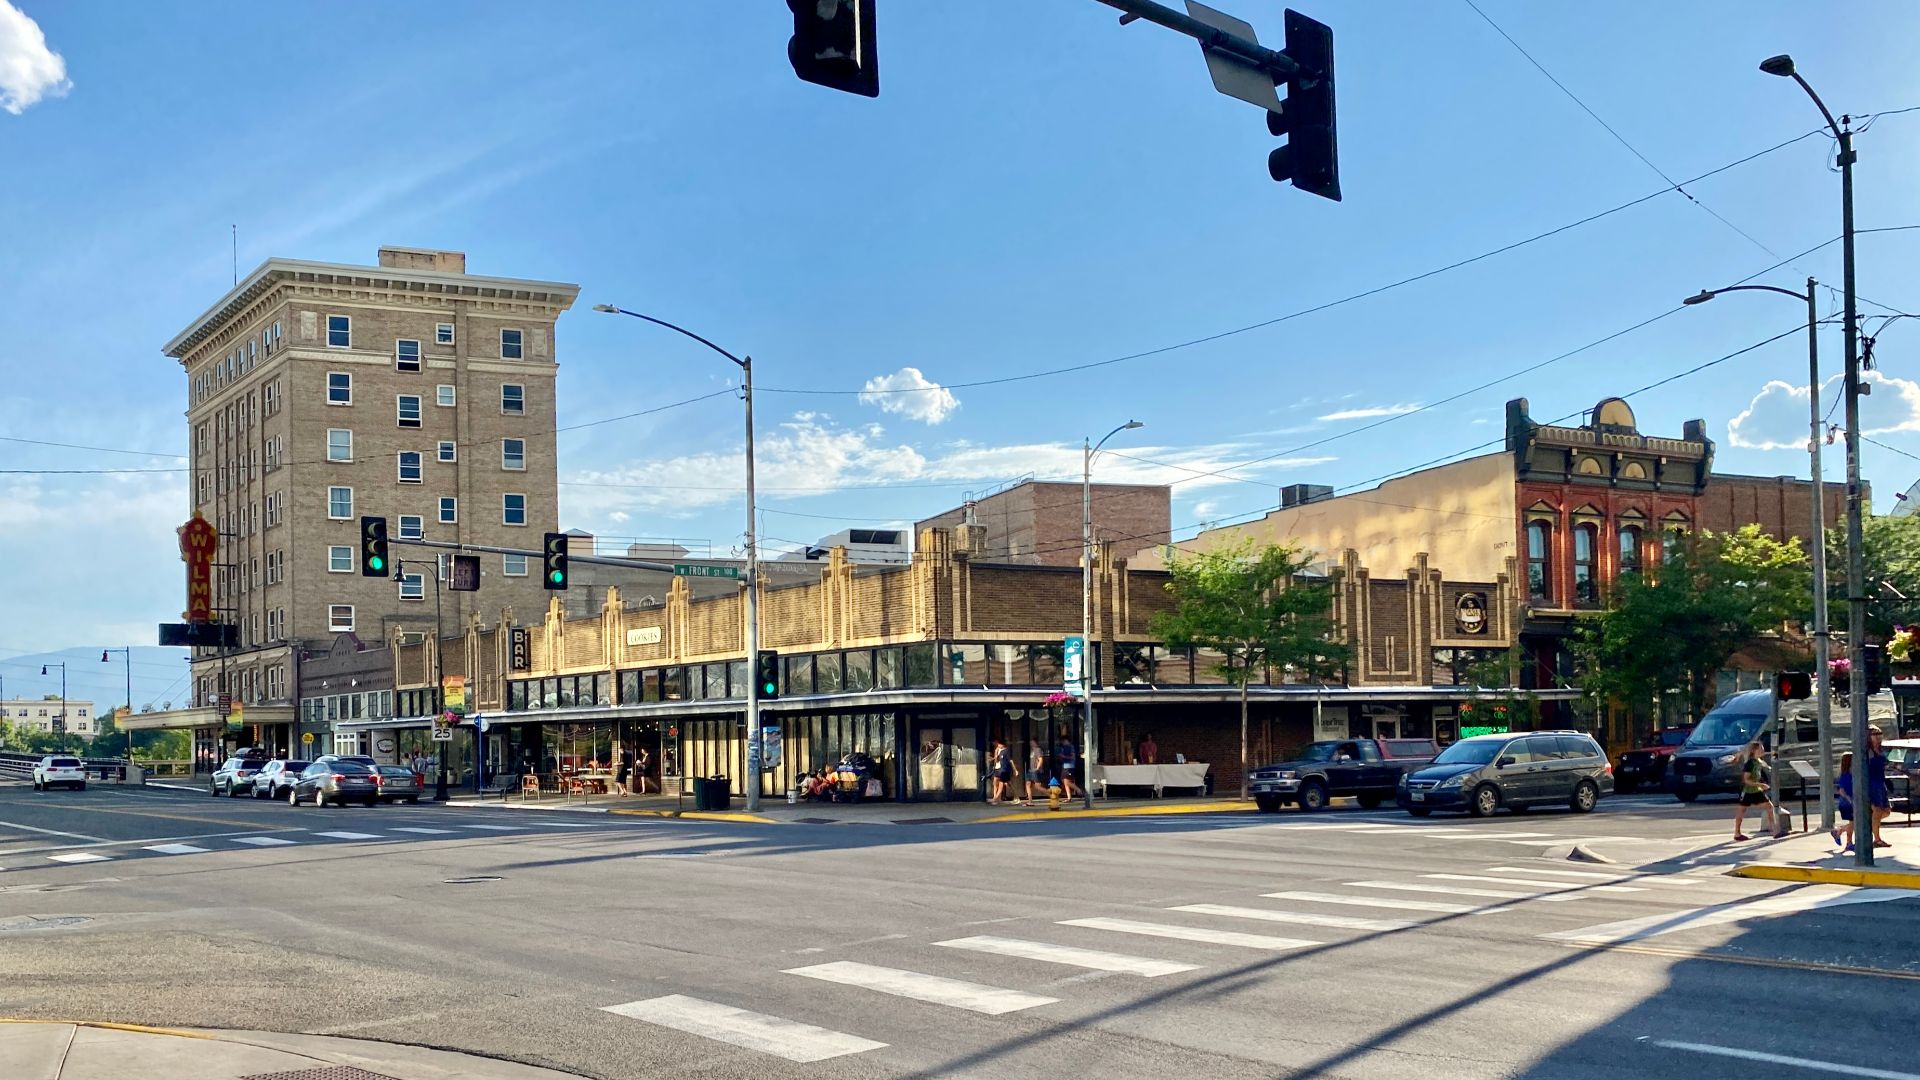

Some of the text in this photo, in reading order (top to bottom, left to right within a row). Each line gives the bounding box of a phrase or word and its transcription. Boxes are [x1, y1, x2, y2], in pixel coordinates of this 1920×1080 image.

[189, 532, 208, 612] WILMA
[689, 566, 709, 577] FRONT
[713, 568, 720, 577] ST
[514, 631, 525, 668] BAR
[434, 728, 451, 739] 25
